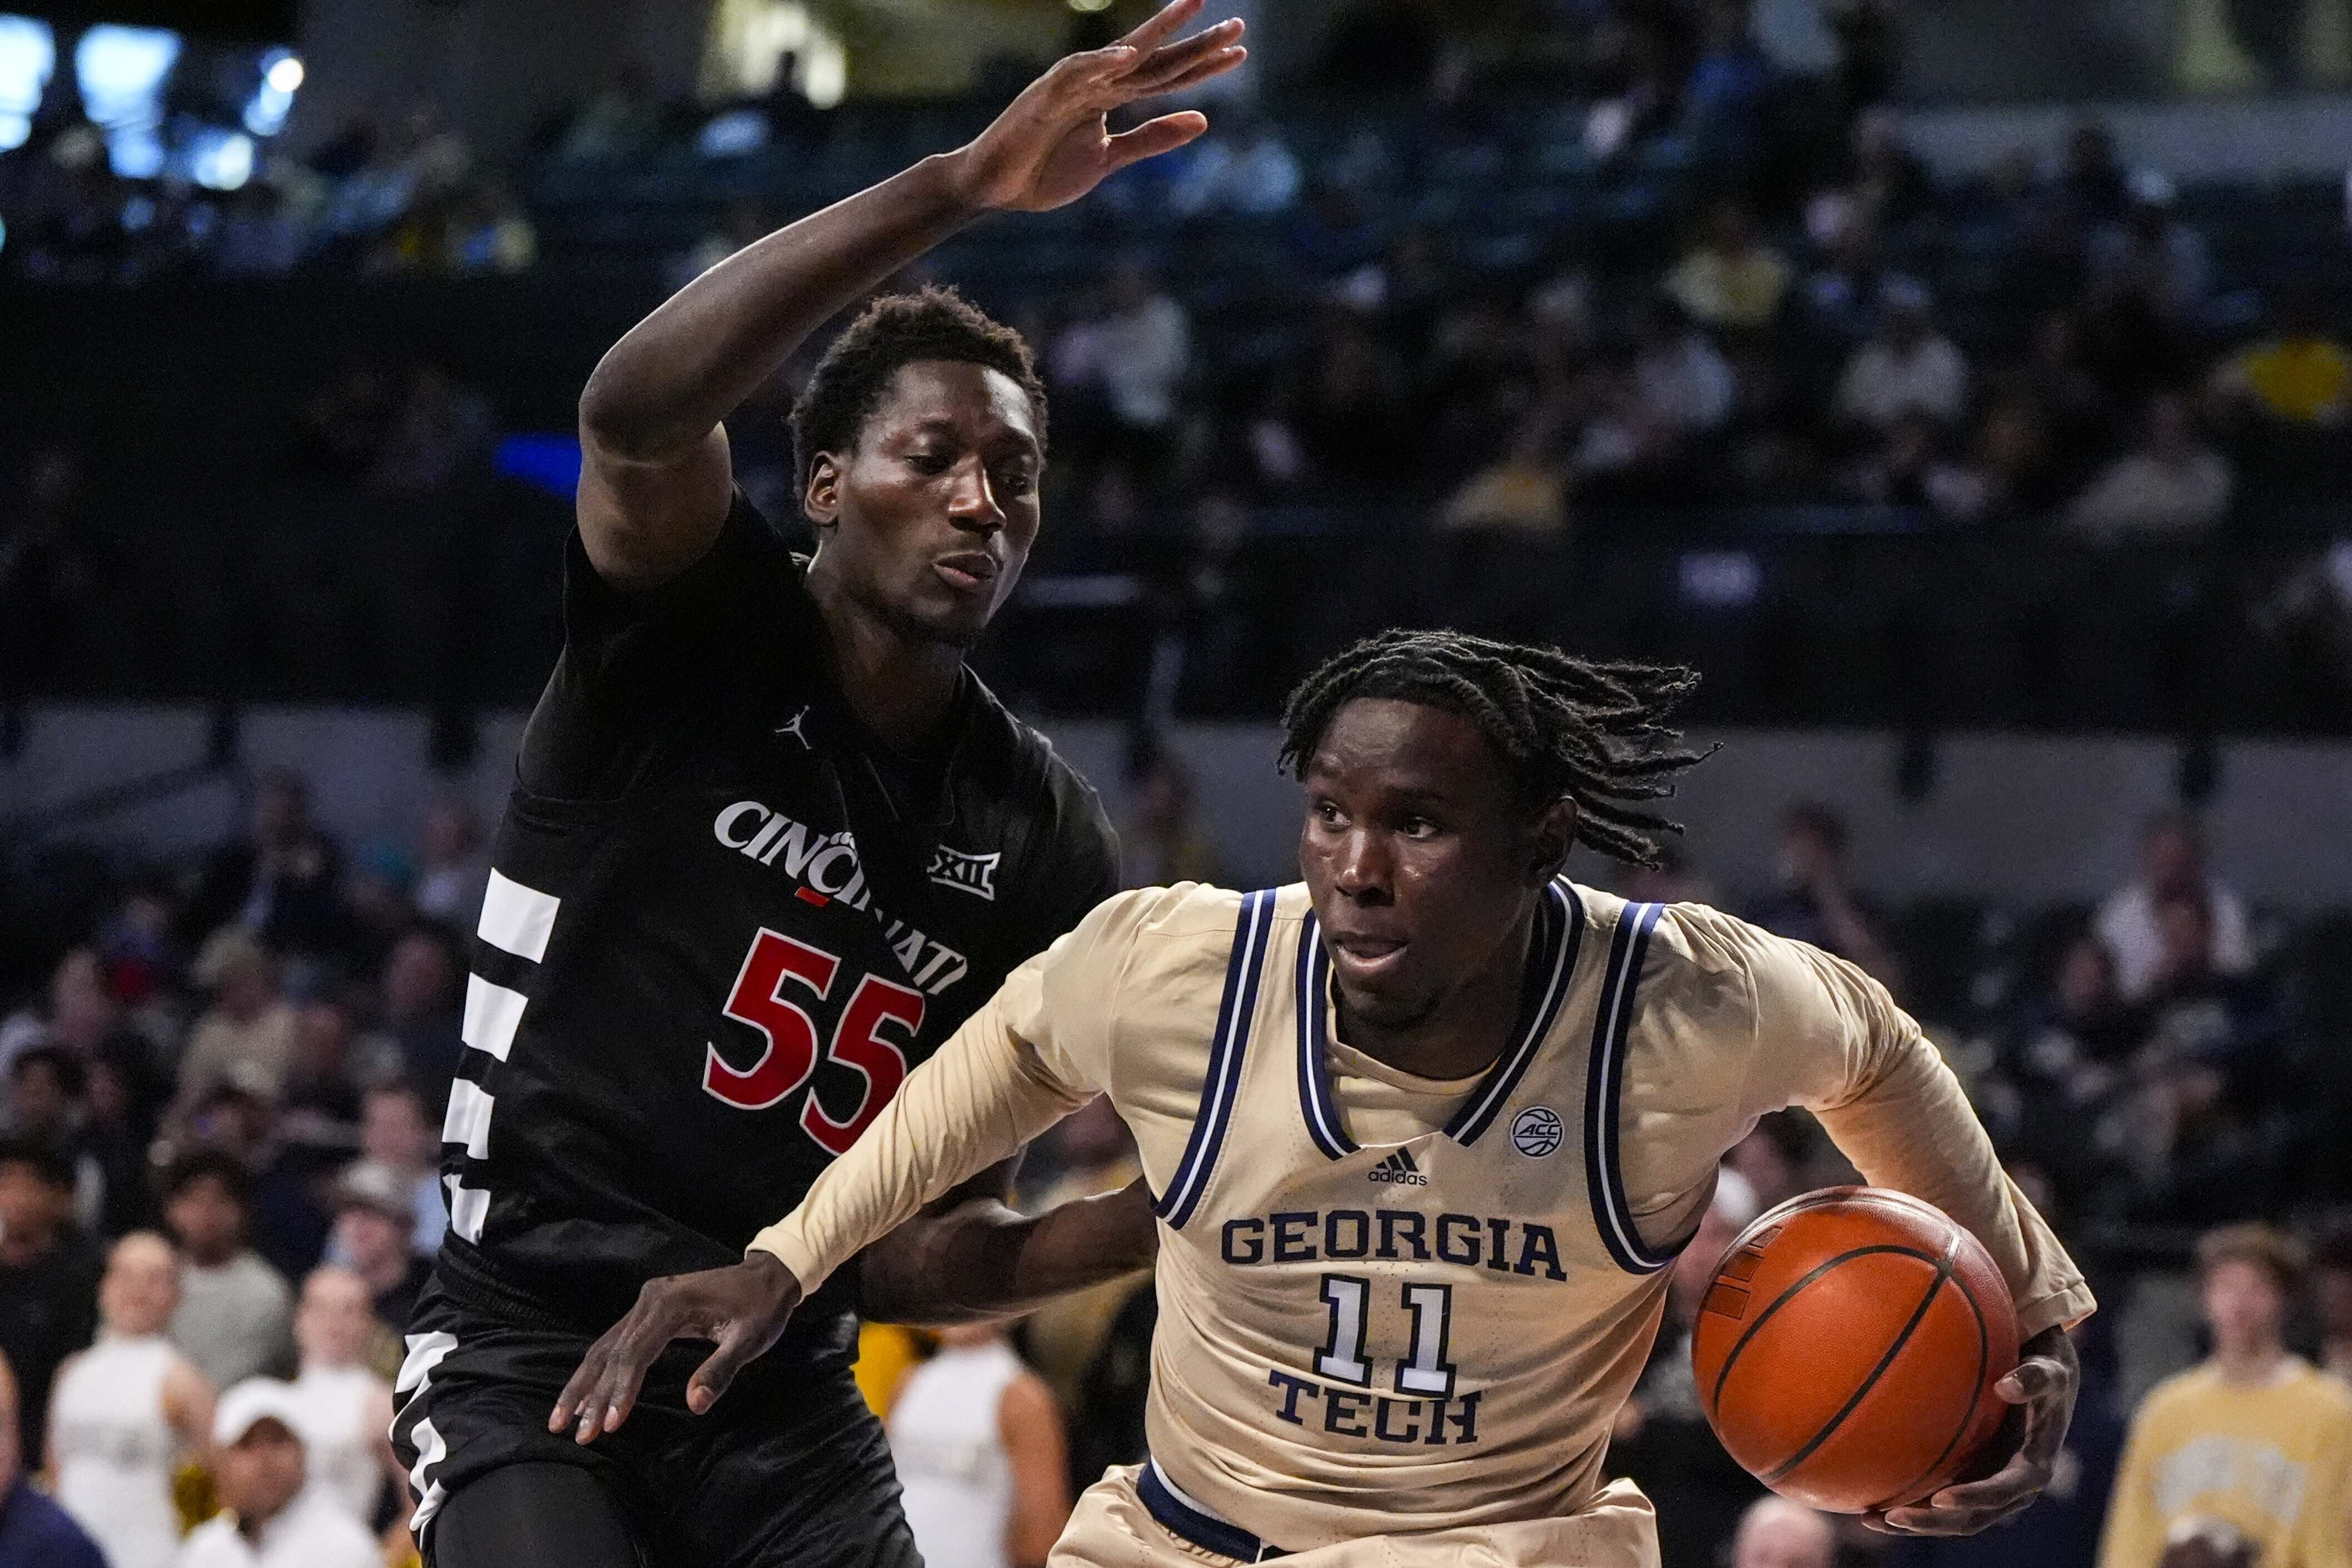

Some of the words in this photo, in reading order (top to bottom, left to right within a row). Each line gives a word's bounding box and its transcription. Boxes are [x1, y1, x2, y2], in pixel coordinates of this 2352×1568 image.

[714, 800, 968, 995] CINCIATI
[703, 927, 926, 1157] 55
[1518, 1123, 1561, 1136] ACC
[1368, 1169, 1428, 1186] adidas
[1222, 1209, 1567, 1282] GEORGIA
[1313, 1273, 1456, 1400] 11
[1269, 1370, 1482, 1445] TECH
